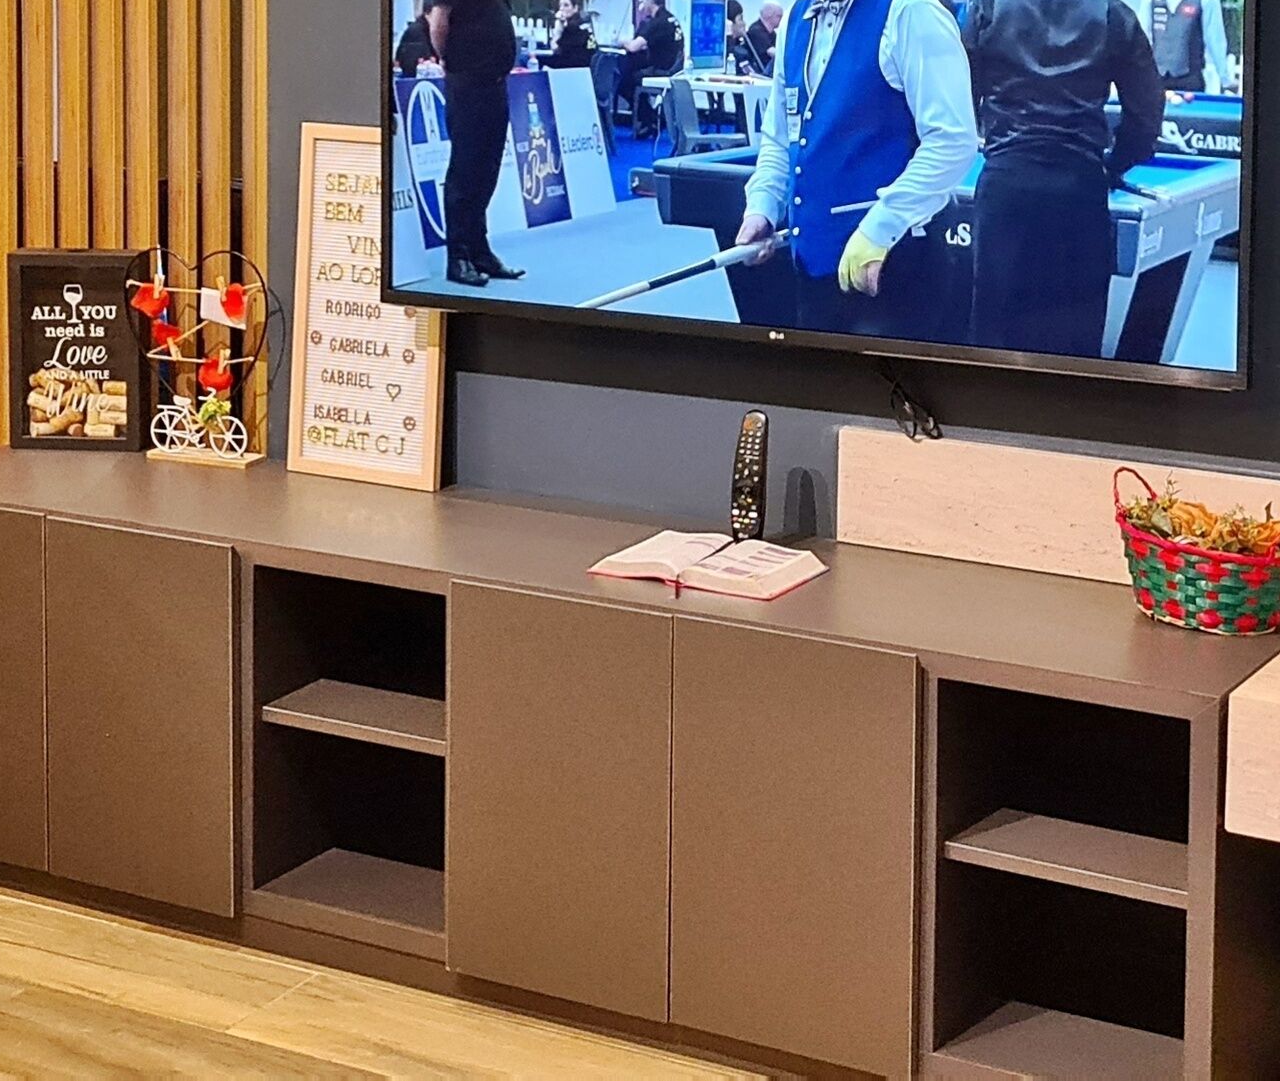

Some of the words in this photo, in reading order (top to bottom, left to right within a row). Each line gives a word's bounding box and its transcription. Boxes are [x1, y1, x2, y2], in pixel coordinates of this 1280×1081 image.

[324, 200, 364, 224] BEM
[316, 262, 344, 282] AO
[31, 305, 66, 320] ALL
[79, 305, 118, 320] YOU
[325, 299, 382, 319] RODRIGO
[44, 323, 86, 338] need
[89, 323, 106, 338] is
[43, 336, 109, 370] Love
[329, 337, 390, 358] GABRIELA
[43, 369, 68, 380] AND
[79, 369, 110, 380] LITTLE
[320, 368, 375, 390] GABRIEL
[43, 380, 111, 418] Wine
[313, 404, 373, 426] ISABELLA
